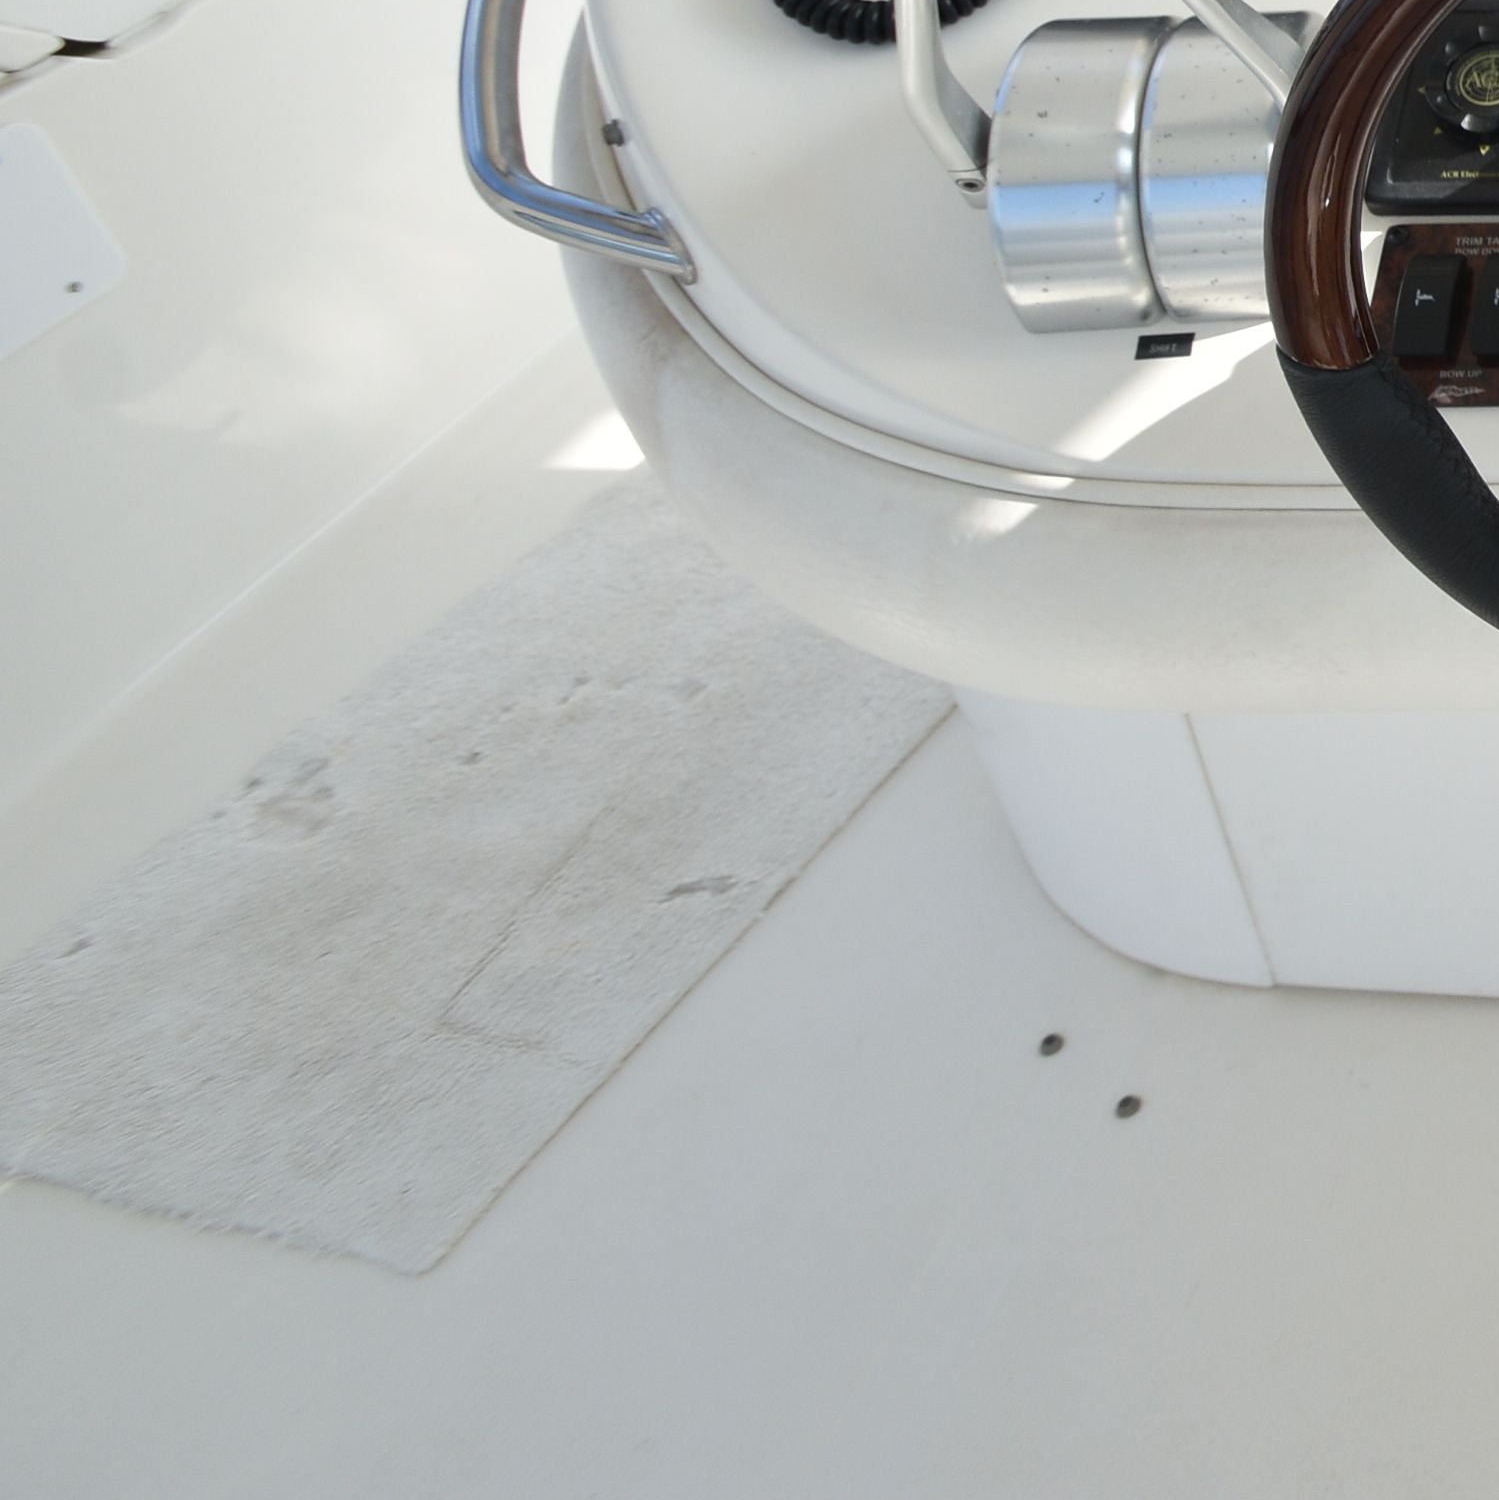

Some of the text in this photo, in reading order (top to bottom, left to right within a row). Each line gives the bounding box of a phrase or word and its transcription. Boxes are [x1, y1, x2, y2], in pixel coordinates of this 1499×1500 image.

[1440, 169, 1459, 180] ACR
[1455, 236, 1484, 246] TRIM
[1439, 369, 1483, 379] BOW UP
